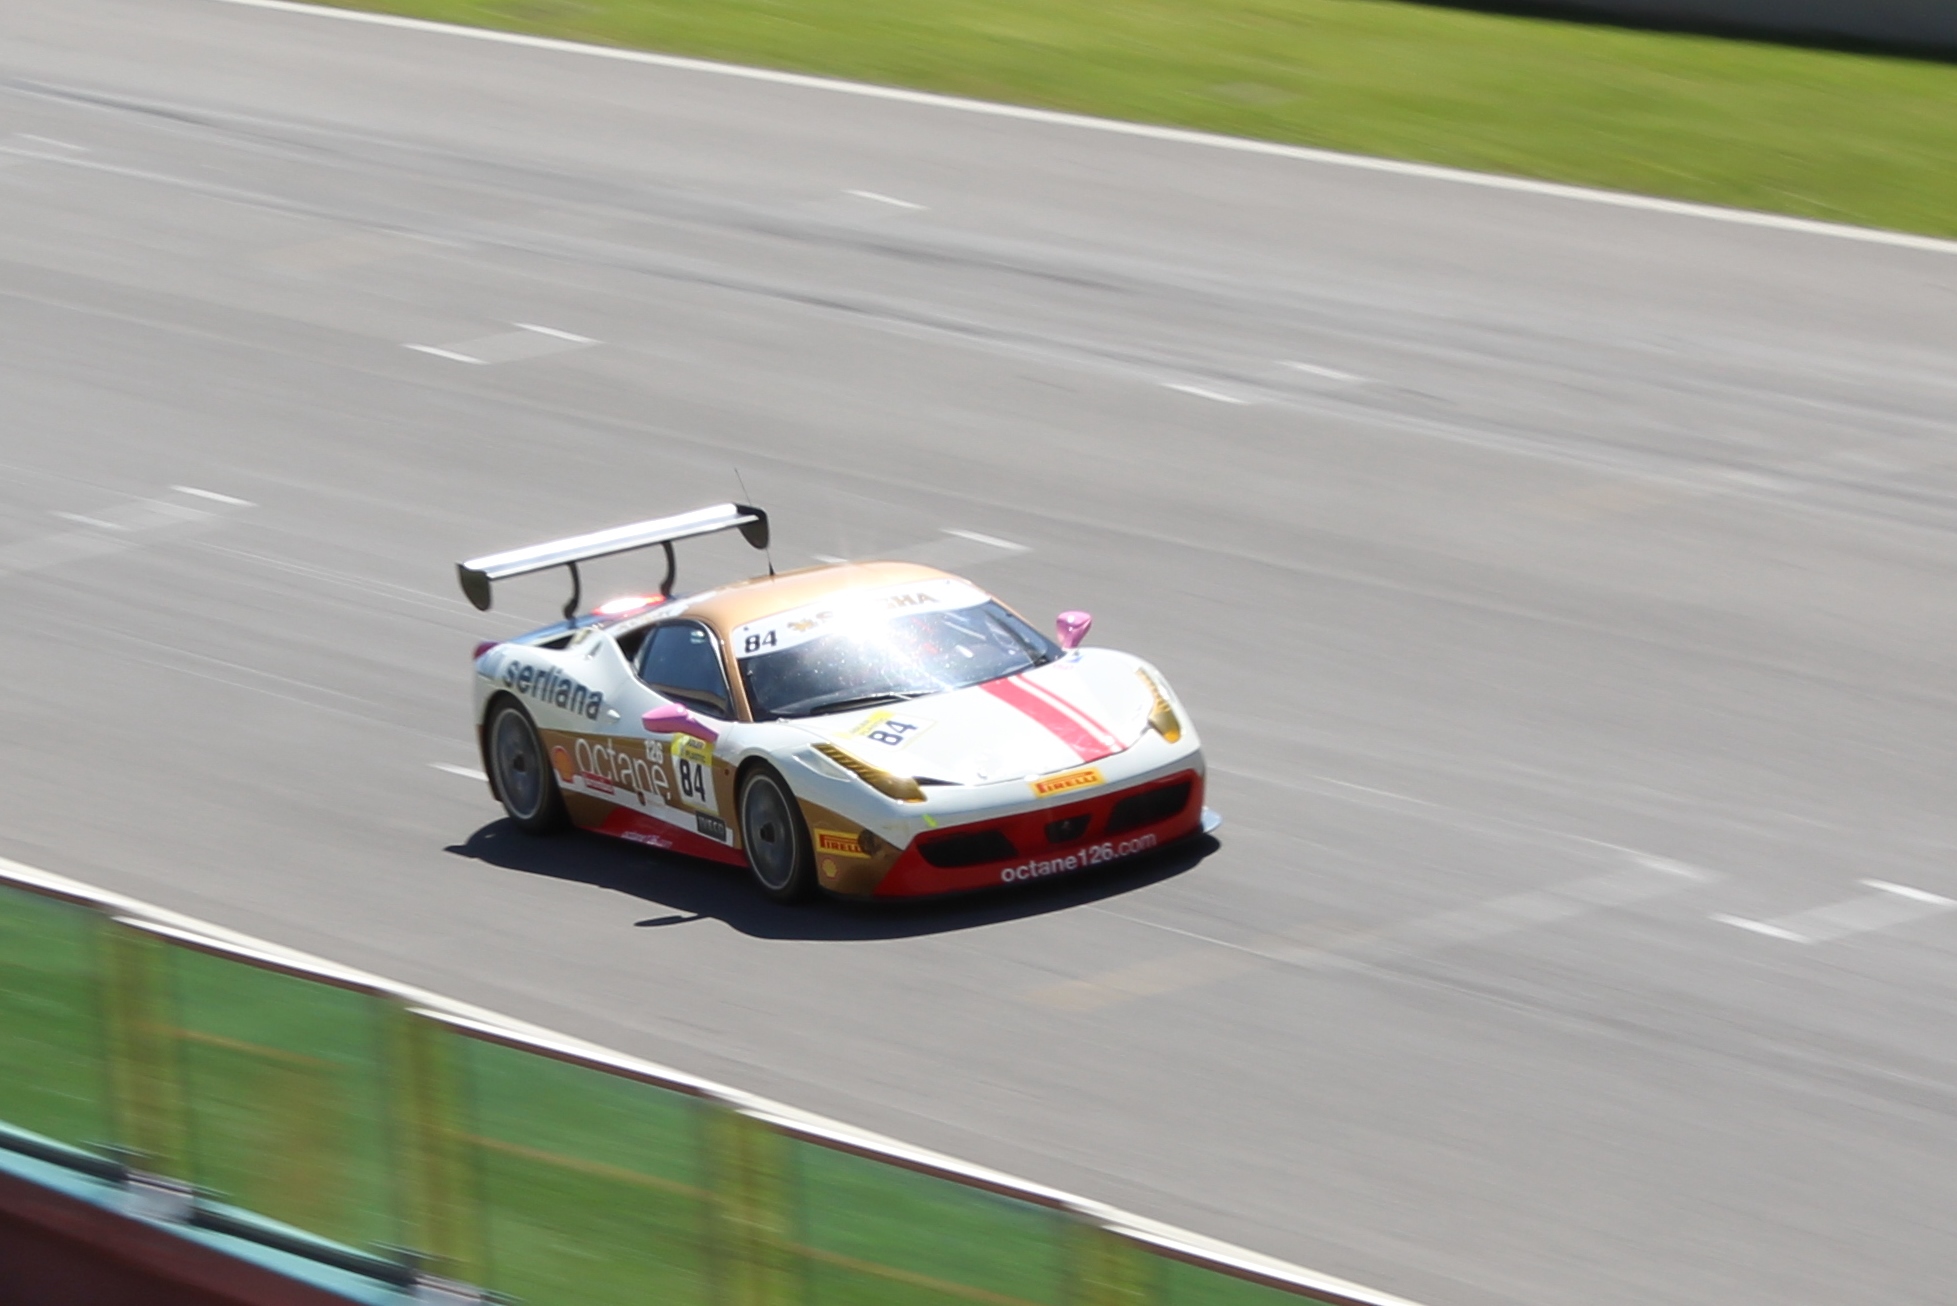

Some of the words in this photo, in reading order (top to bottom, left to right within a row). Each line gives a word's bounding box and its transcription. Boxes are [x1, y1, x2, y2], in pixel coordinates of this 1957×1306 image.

[744, 630, 777, 653] 84
[503, 660, 603, 720] serliana
[866, 720, 918, 746] 84
[680, 758, 706, 802] 84
[1036, 771, 1098, 793] PIRELLI
[1001, 833, 1157, 882] octane126.com
